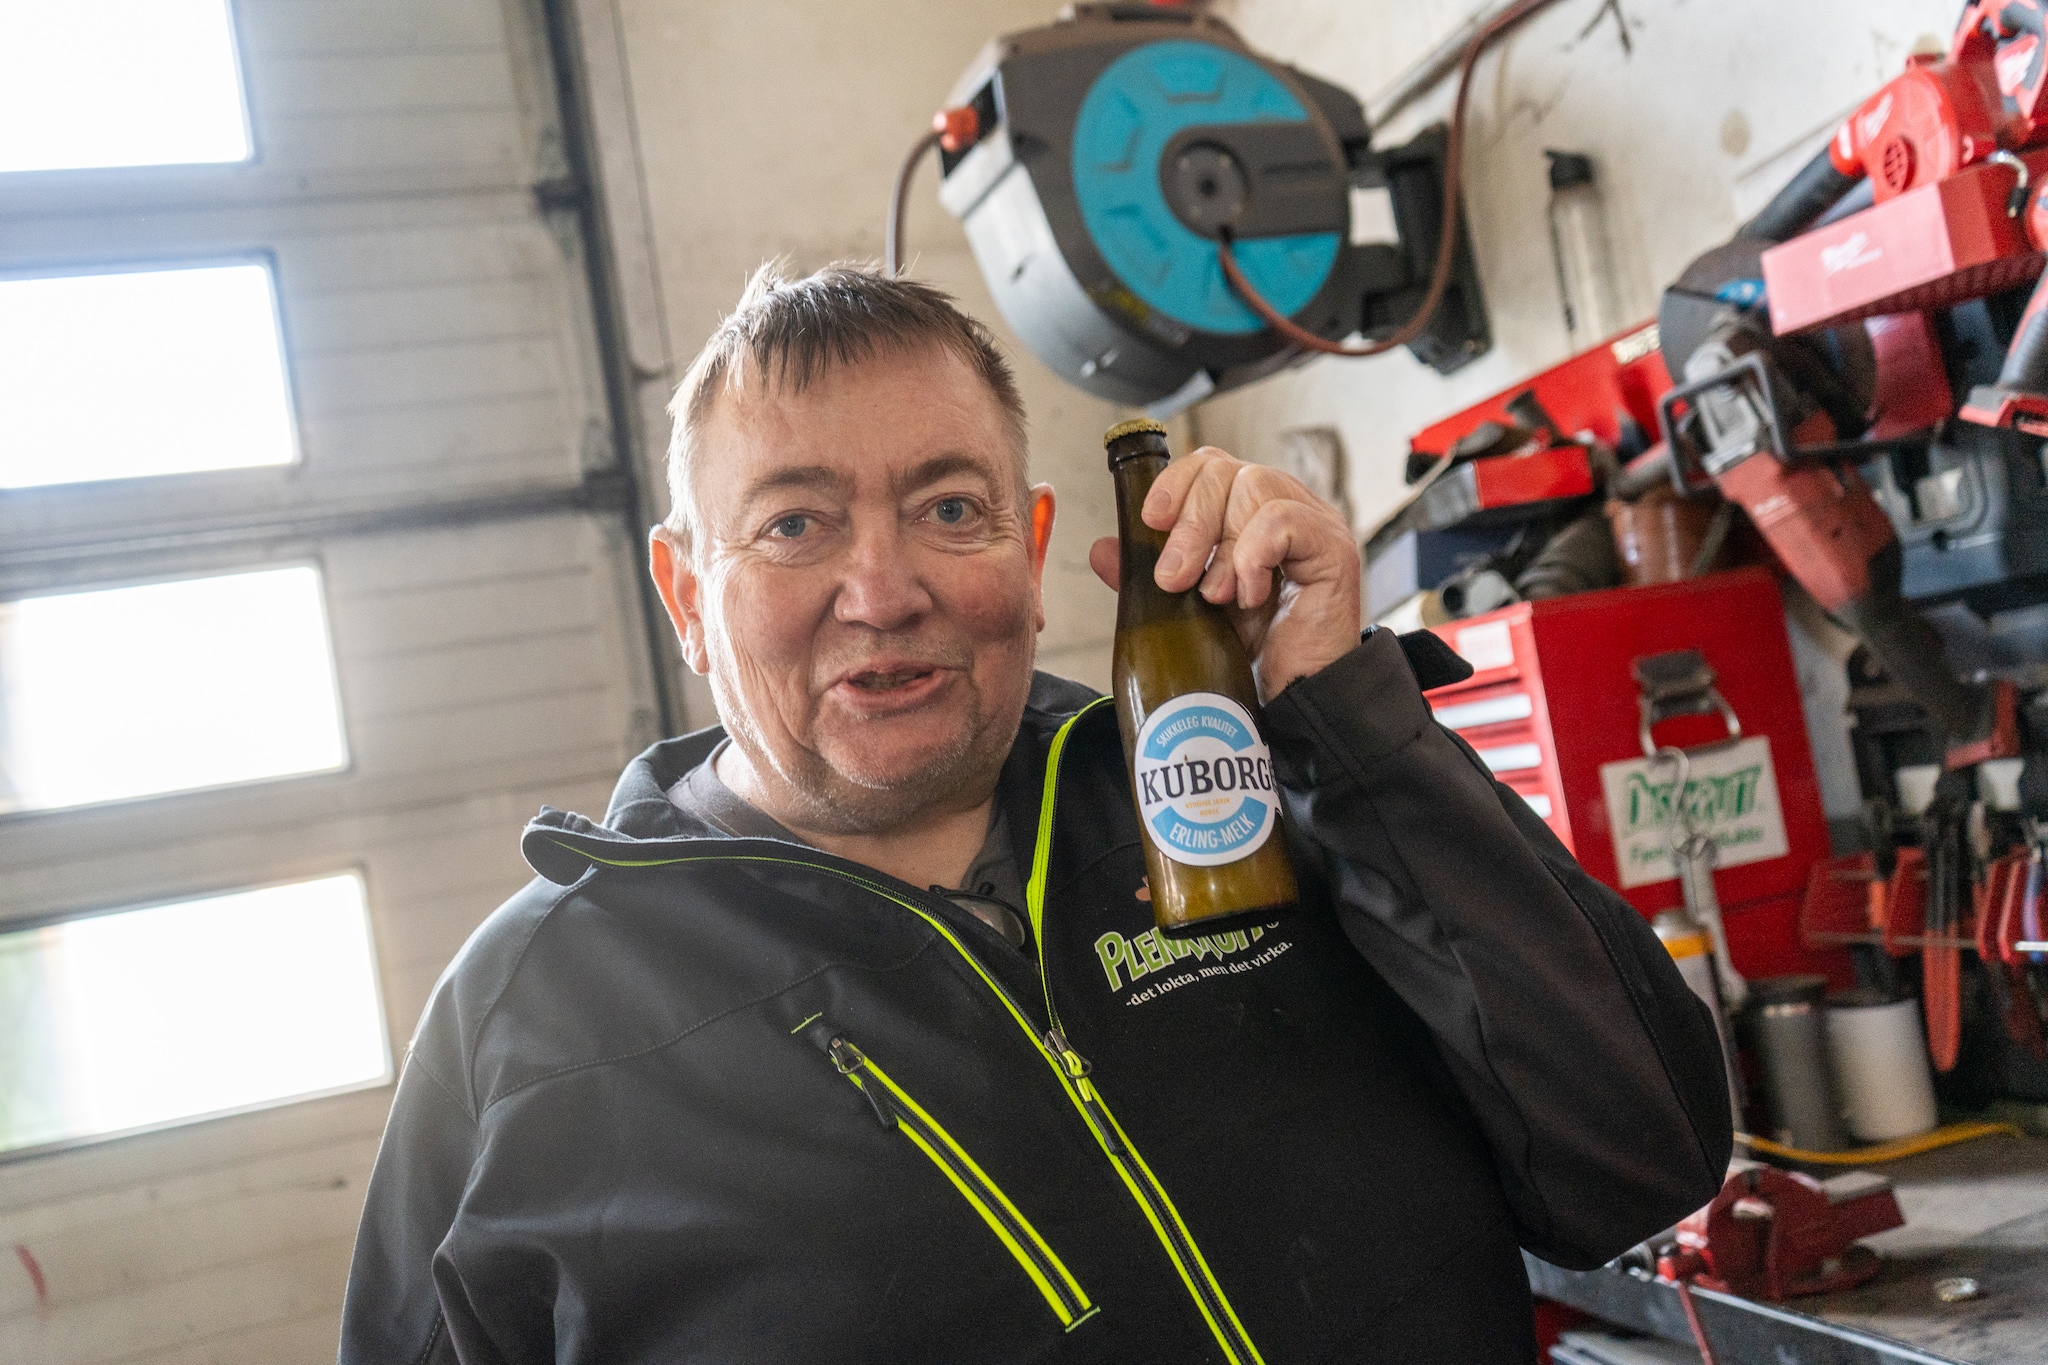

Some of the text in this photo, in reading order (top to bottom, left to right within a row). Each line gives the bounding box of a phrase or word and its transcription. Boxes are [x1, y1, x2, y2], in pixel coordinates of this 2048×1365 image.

[1156, 715, 1239, 748] SKIKKELEG KVALITET
[1140, 756, 1277, 806] KUBORG
[1169, 812, 1256, 850] ERLING-MELK
[1157, 971, 1200, 995] lokta,
[1198, 963, 1229, 978] men
[1229, 959, 1252, 974] det
[1251, 941, 1293, 968] virka.
